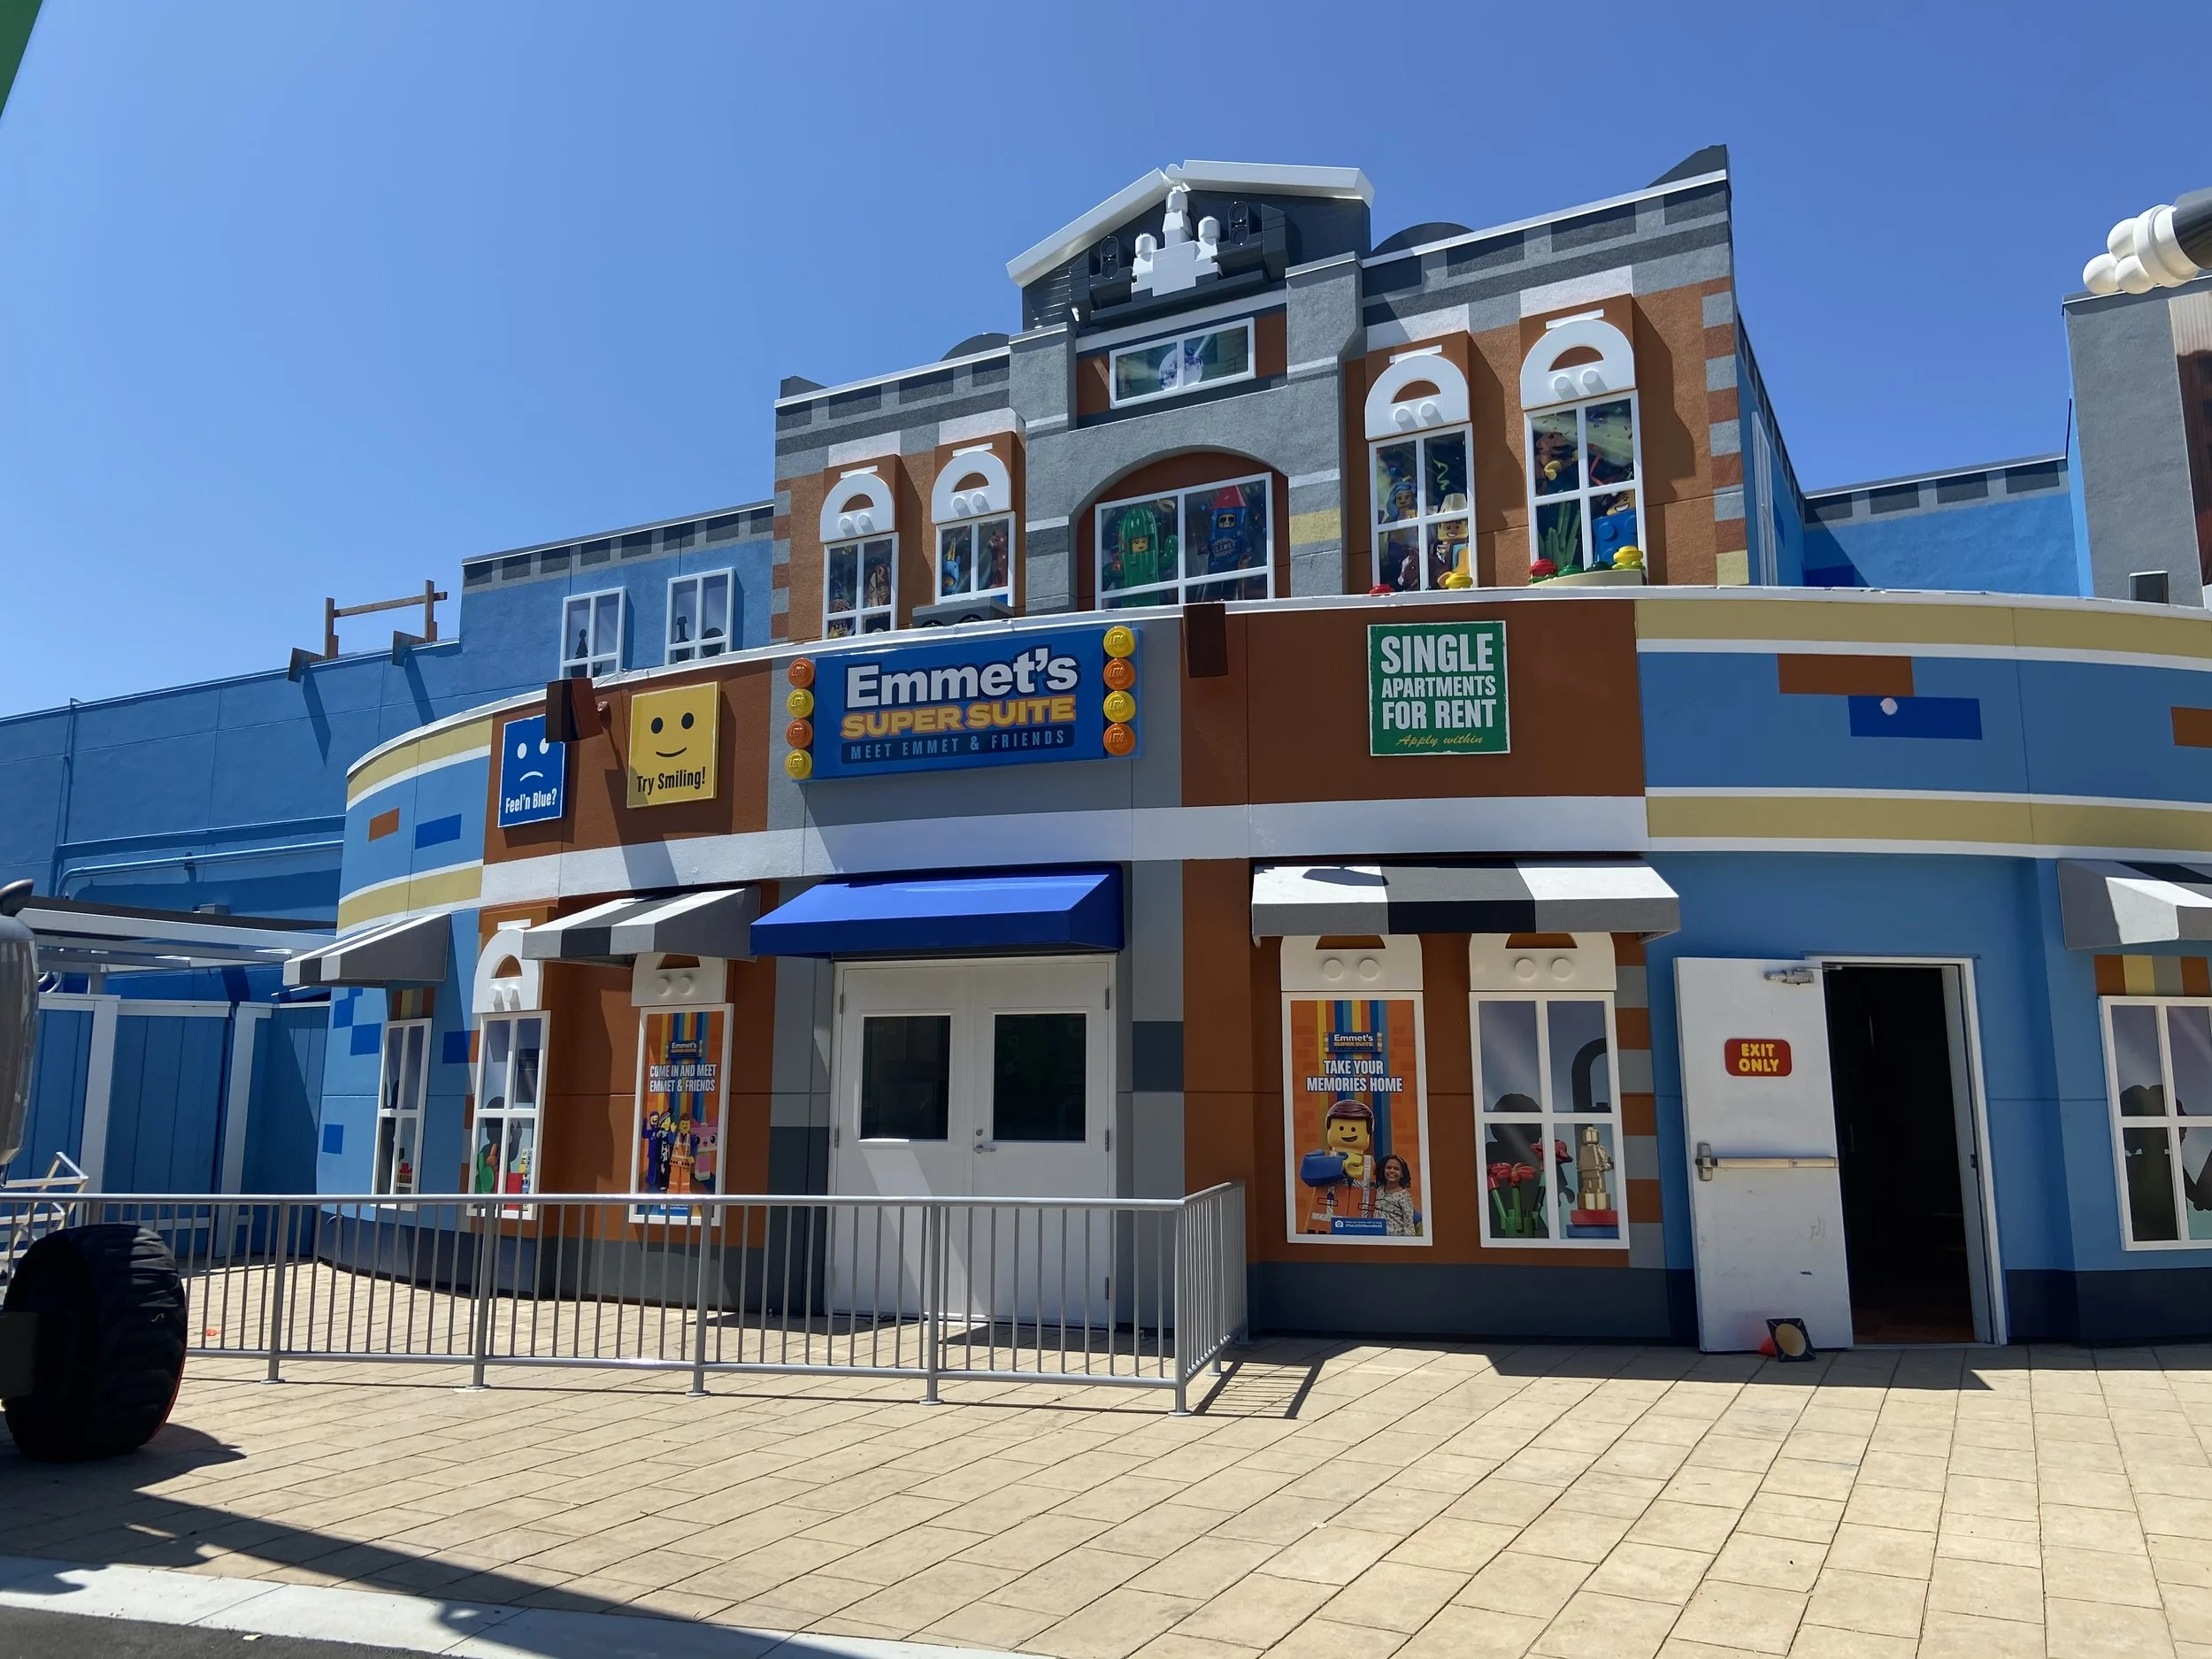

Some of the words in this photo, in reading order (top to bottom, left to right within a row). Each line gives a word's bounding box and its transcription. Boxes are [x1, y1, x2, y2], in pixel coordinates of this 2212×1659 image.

[1380, 633, 1494, 674] SINGLE
[847, 648, 1078, 709] Emmet's
[1381, 675, 1496, 698] APARTMENTS
[841, 704, 965, 740] SUPER
[966, 695, 1076, 729] SUITE
[1382, 701, 1427, 730] FOR
[1434, 699, 1496, 729] RENT
[851, 743, 892, 760] MEET
[902, 738, 958, 756] EMMET
[970, 735, 979, 750] &
[991, 729, 1064, 749] FRIENDS
[1395, 733, 1439, 748] Apply
[1443, 733, 1484, 744] within
[636, 775, 655, 795] Try
[657, 766, 706, 790] Smiling!
[504, 793, 531, 814] Feel'n
[532, 787, 557, 809] Blue?
[1333, 1033, 1374, 1042] Emmet's
[1740, 1043, 1775, 1057] EXIT
[649, 1064, 671, 1078] COME
[671, 1064, 680, 1077] IN
[680, 1064, 695, 1077] AND
[696, 1064, 717, 1077] MEET
[1323, 1060, 1352, 1075] TAKE
[1353, 1060, 1384, 1075] YOUR
[1738, 1057, 1779, 1072] ONLY
[649, 1079, 676, 1093] EMMET
[676, 1079, 683, 1092] &
[685, 1079, 716, 1092] FRIENDS
[1306, 1077, 1368, 1092] MEMORIES
[1369, 1077, 1403, 1092] HOME
